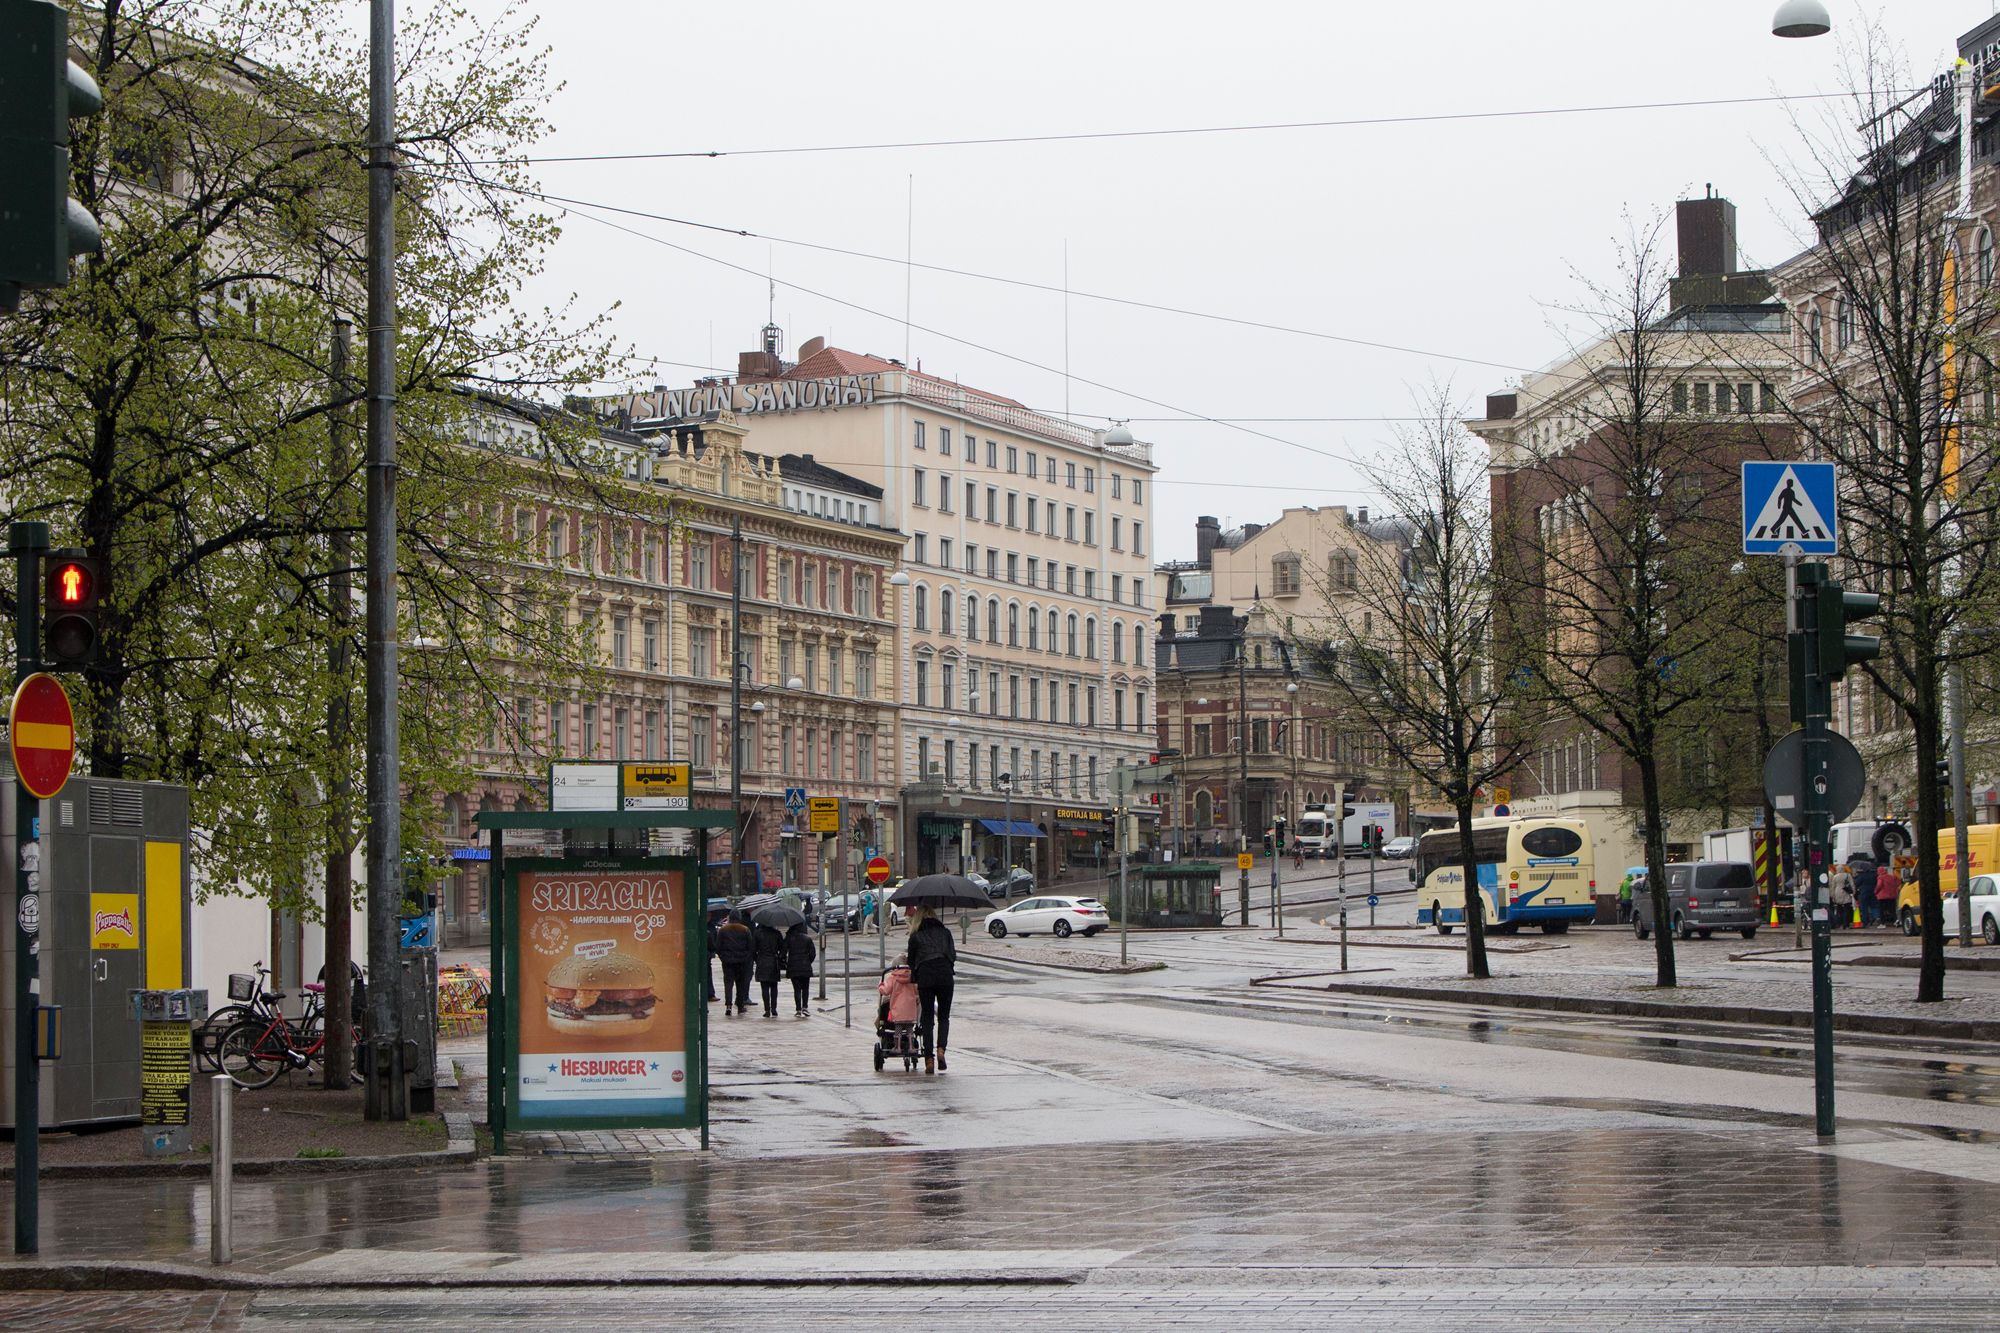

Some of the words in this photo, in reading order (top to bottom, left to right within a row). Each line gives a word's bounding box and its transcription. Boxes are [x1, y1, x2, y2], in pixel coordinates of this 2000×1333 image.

[741, 373, 880, 414] SANOMAT
[554, 777, 566, 786] 24
[666, 798, 689, 807] 1901
[1057, 809, 1088, 819] EROTTAJA
[1089, 810, 1103, 820] BAR
[1943, 852, 1977, 870] DL
[532, 879, 673, 912] SRIRACHA
[569, 915, 632, 924] -HAMPURILAINEN
[561, 1059, 647, 1077] HESBURGER
